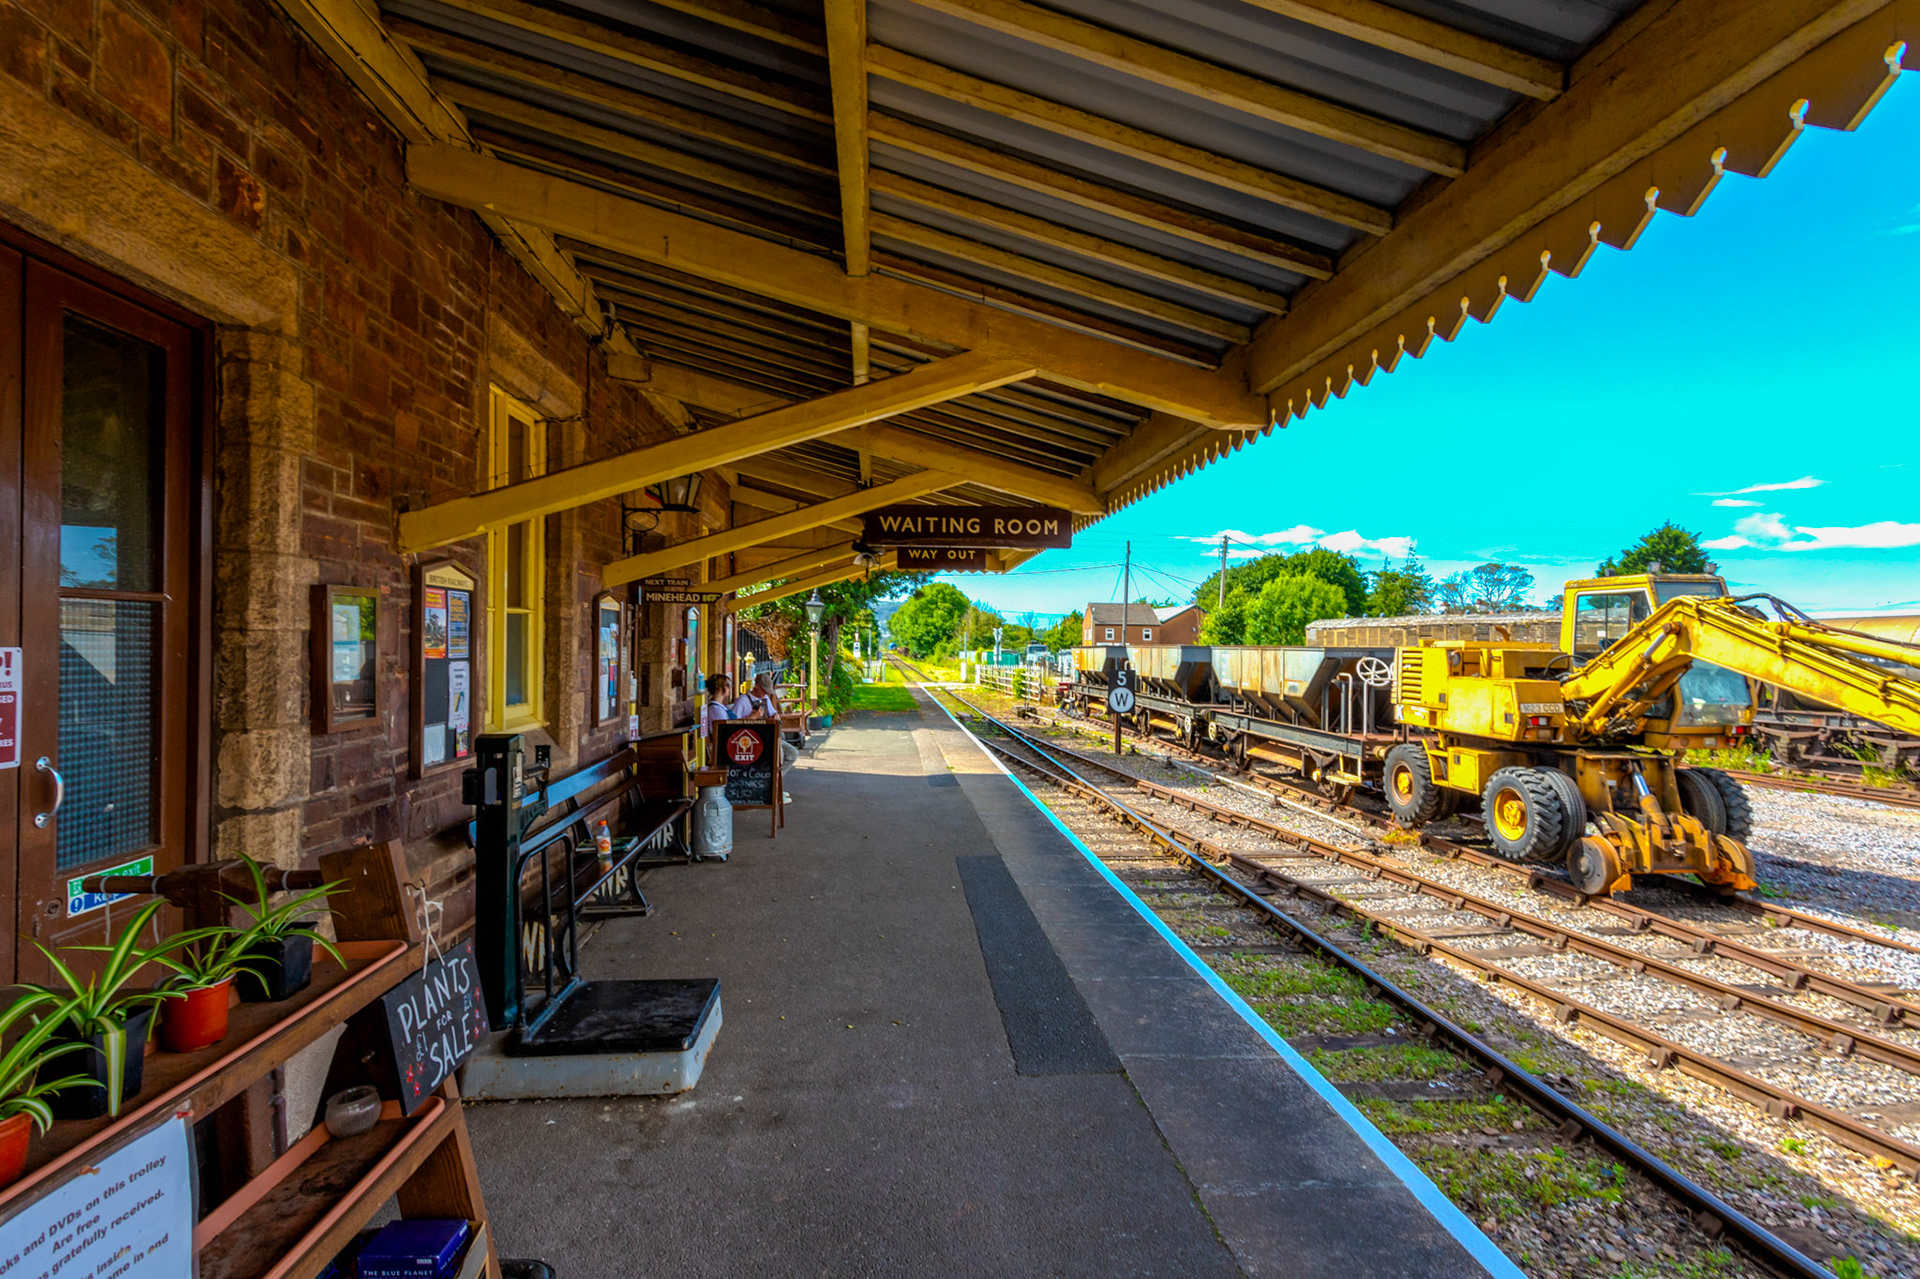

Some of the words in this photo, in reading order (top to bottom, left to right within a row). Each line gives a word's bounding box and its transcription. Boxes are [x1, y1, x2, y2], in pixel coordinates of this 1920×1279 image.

[879, 515, 981, 534] WAITING
[994, 519, 1059, 536] ROOM
[909, 549, 937, 560] WAY
[947, 550, 975, 560] OUT
[646, 592, 700, 602] MINEHEAD
[1116, 671, 1127, 686] 5
[1115, 693, 1129, 706] W
[729, 769, 741, 777] OT
[397, 958, 470, 1044] PLANTS
[436, 1010, 453, 1031] FOR
[430, 1012, 473, 1087] SALE
[23, 1231, 45, 1256] and
[49, 1209, 82, 1236] DVDs
[85, 1197, 100, 1212] on
[103, 1180, 126, 1199] this
[129, 1155, 166, 1183] trolley
[52, 1226, 108, 1275] gratefully
[110, 1188, 164, 1229] received.
[52, 1233, 73, 1254] Are
[76, 1214, 100, 1235] free
[133, 1251, 144, 1264] in
[147, 1232, 169, 1254] and
